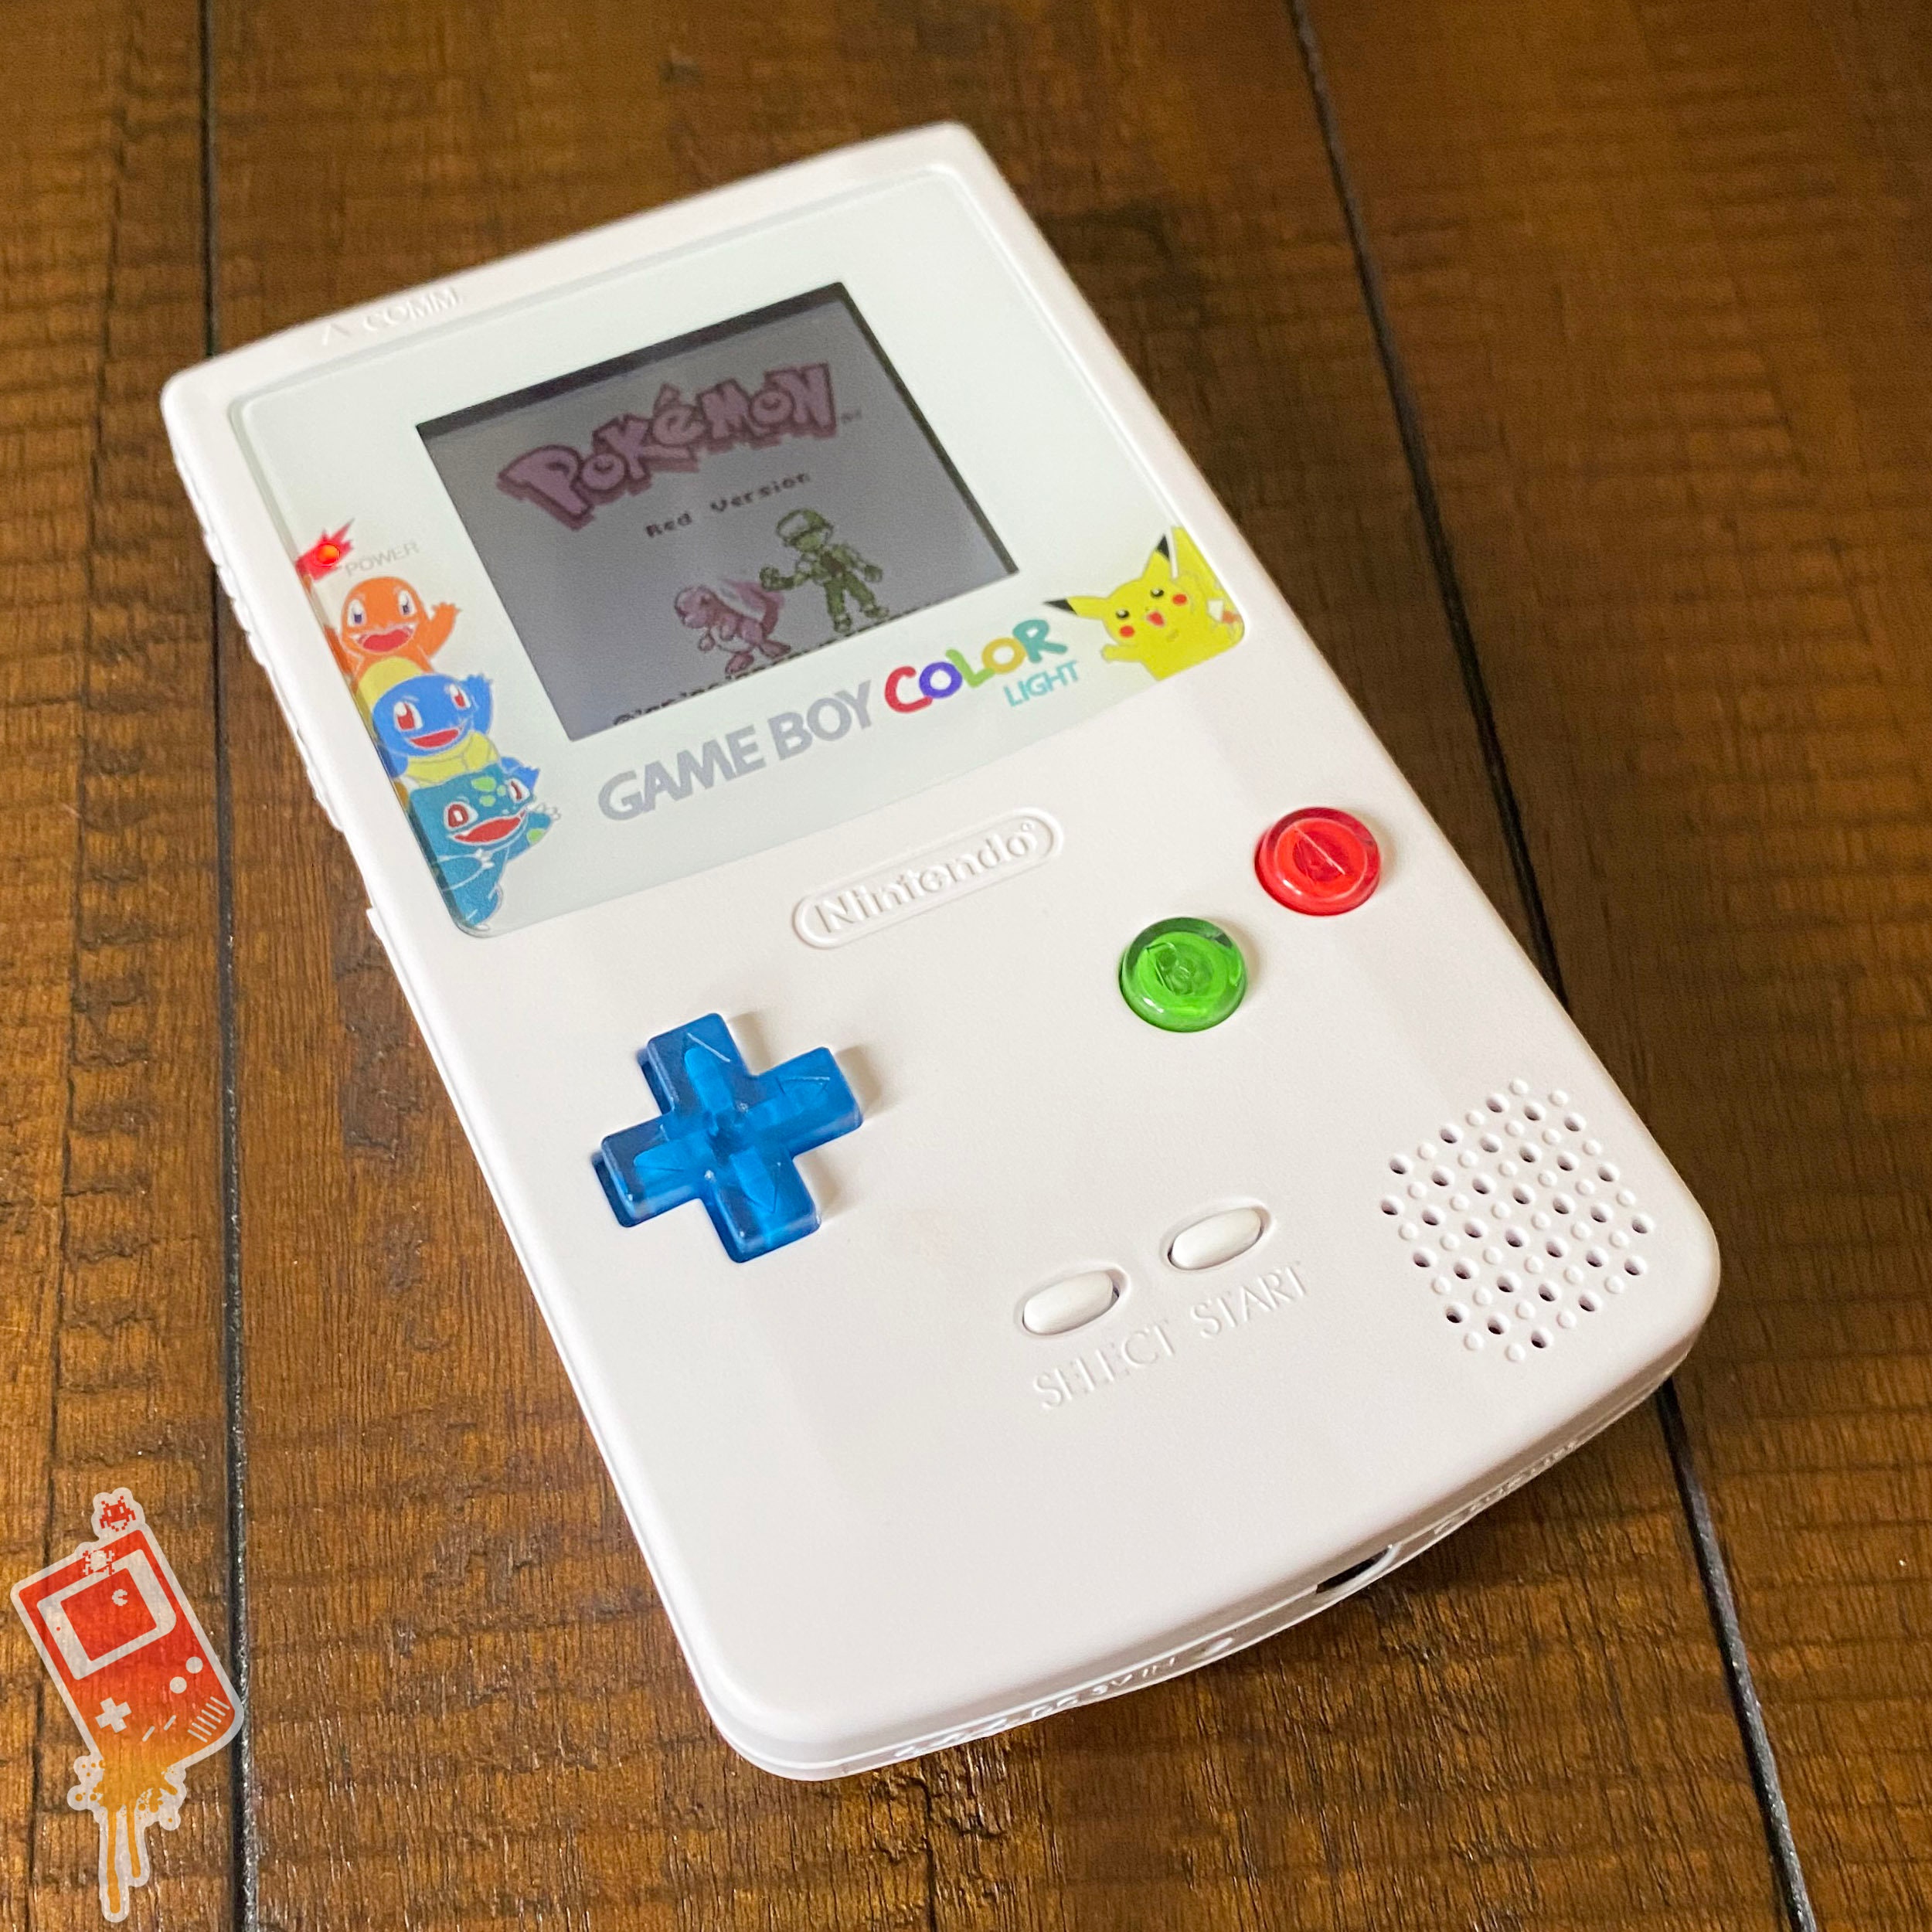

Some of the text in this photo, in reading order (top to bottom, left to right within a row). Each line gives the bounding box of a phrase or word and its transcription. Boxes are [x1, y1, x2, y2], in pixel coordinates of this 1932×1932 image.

[362, 285, 460, 332] COMM
[645, 473, 811, 538] Red Version
[345, 541, 420, 576] POWER
[1003, 660, 1078, 706] LIGHT
[598, 726, 767, 821] GAME
[767, 680, 872, 761] BOY
[884, 619, 1067, 713] COLOR
[1032, 1261, 1308, 1410] SELECT START
